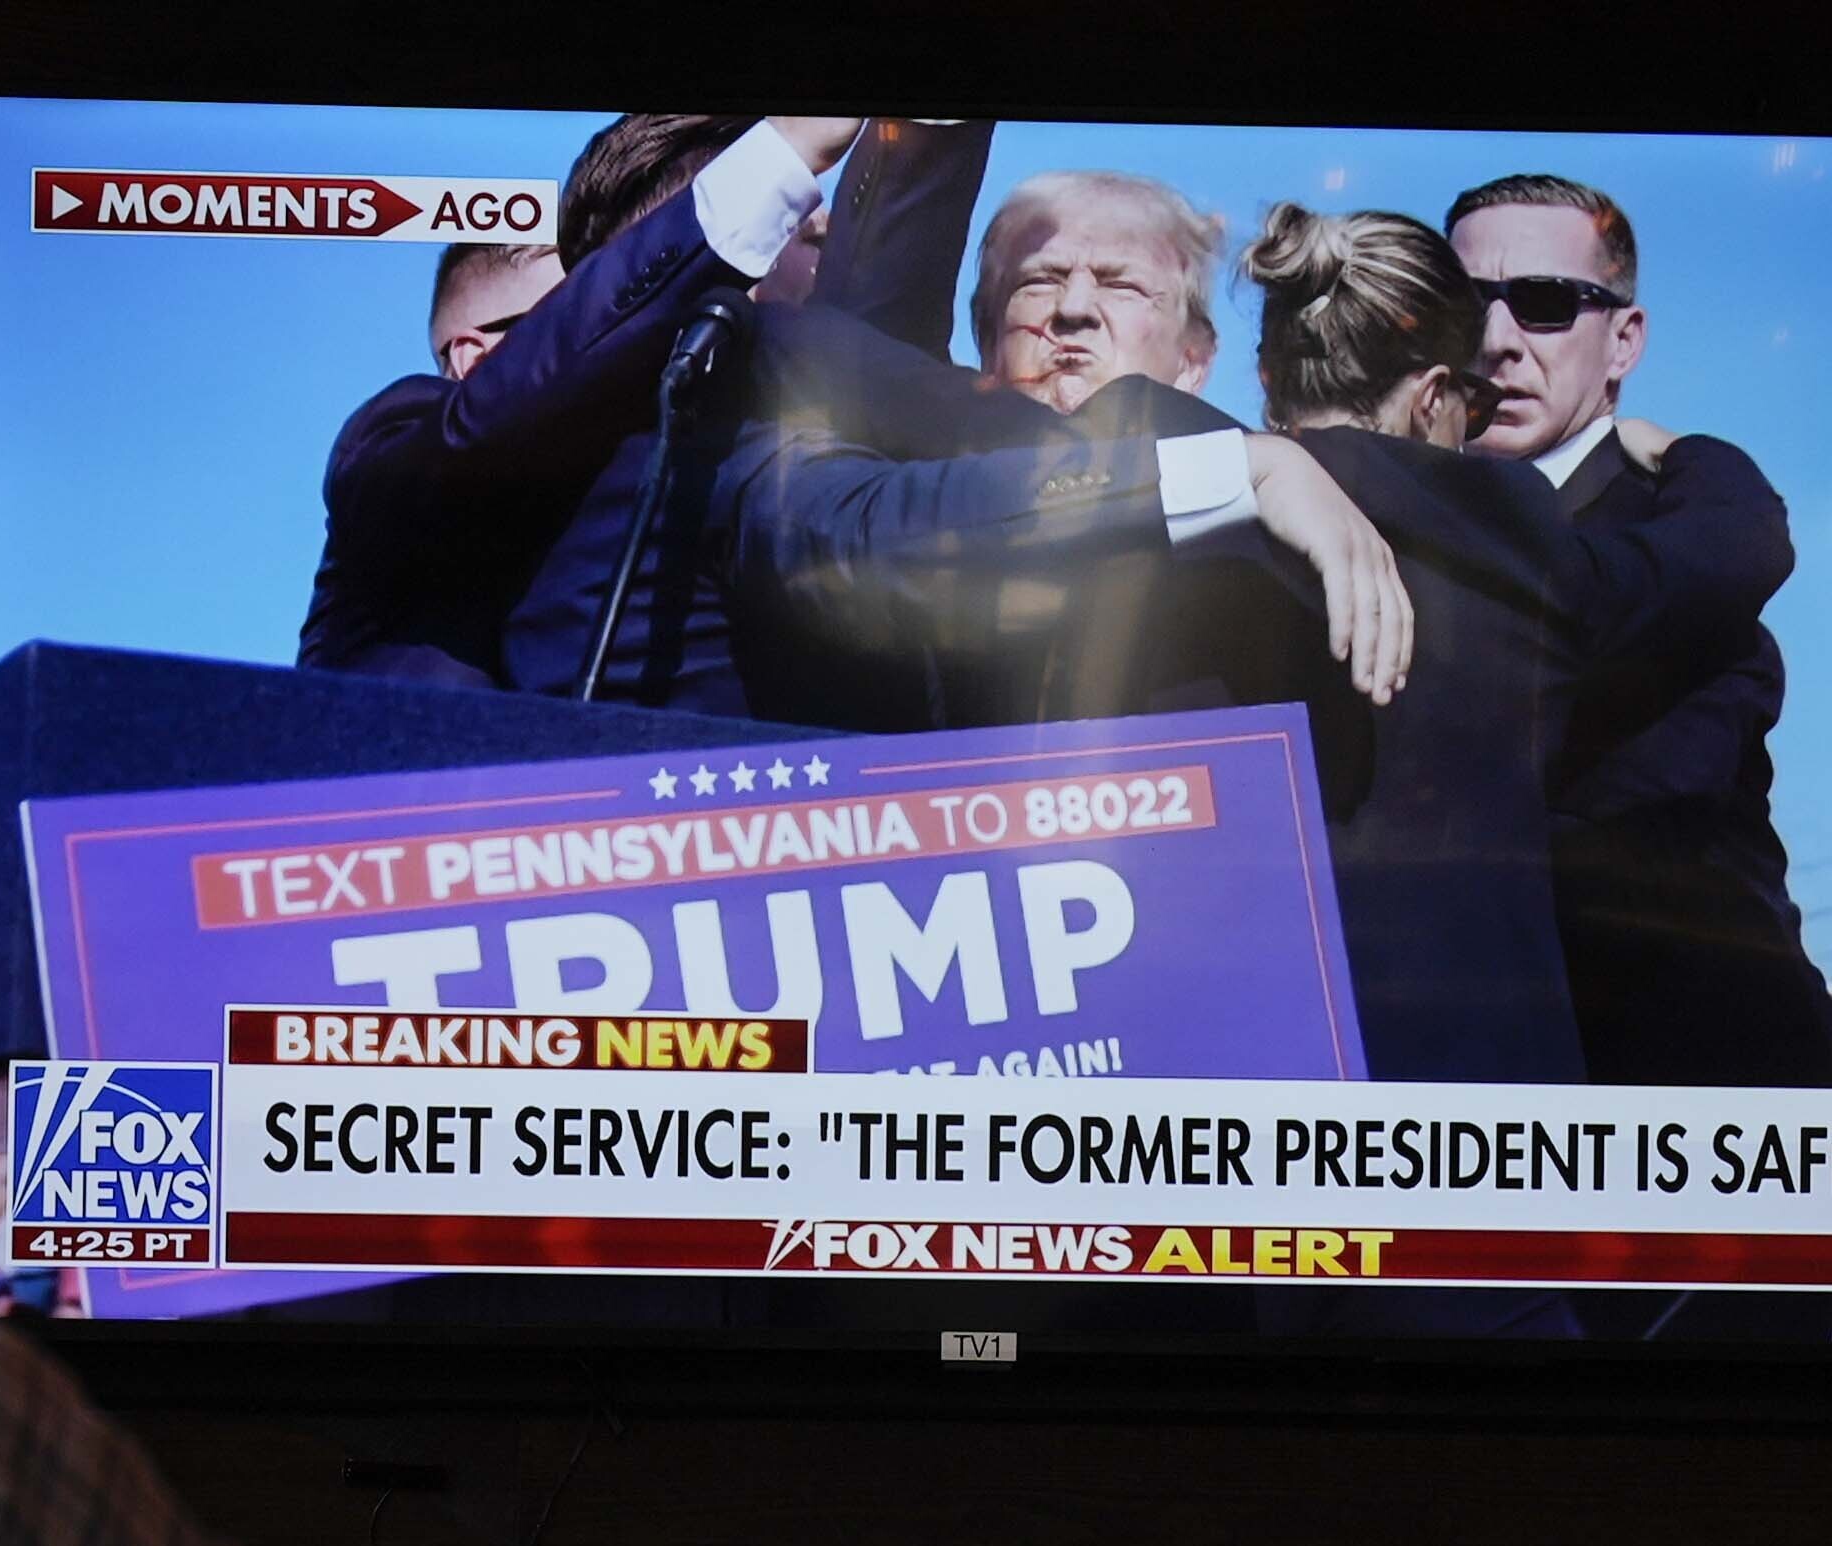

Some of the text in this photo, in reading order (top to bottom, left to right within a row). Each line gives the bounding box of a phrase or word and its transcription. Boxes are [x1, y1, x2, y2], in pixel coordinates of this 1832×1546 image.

[97, 182, 542, 231] MOMENTS AGO
[222, 775, 1193, 918] TEXT PENNSYLVANIA TO 88022
[276, 1015, 773, 1070] BREAKING NEWS
[977, 1037, 1122, 1077] AGAIN!
[80, 1110, 204, 1165] FOX
[264, 1102, 492, 1174] SECRET
[513, 1106, 791, 1178] SERVICE:
[819, 1112, 965, 1181] "THE
[988, 1114, 1253, 1185] FORMER
[1276, 1118, 1616, 1192] PRESIDENT
[1637, 1122, 1689, 1193] IS
[42, 1170, 208, 1220] NEWS
[29, 1230, 191, 1258] 4:25 PT
[813, 1223, 1394, 1276] FOX NEWS ALERT
[953, 1334, 1001, 1359] TV1
